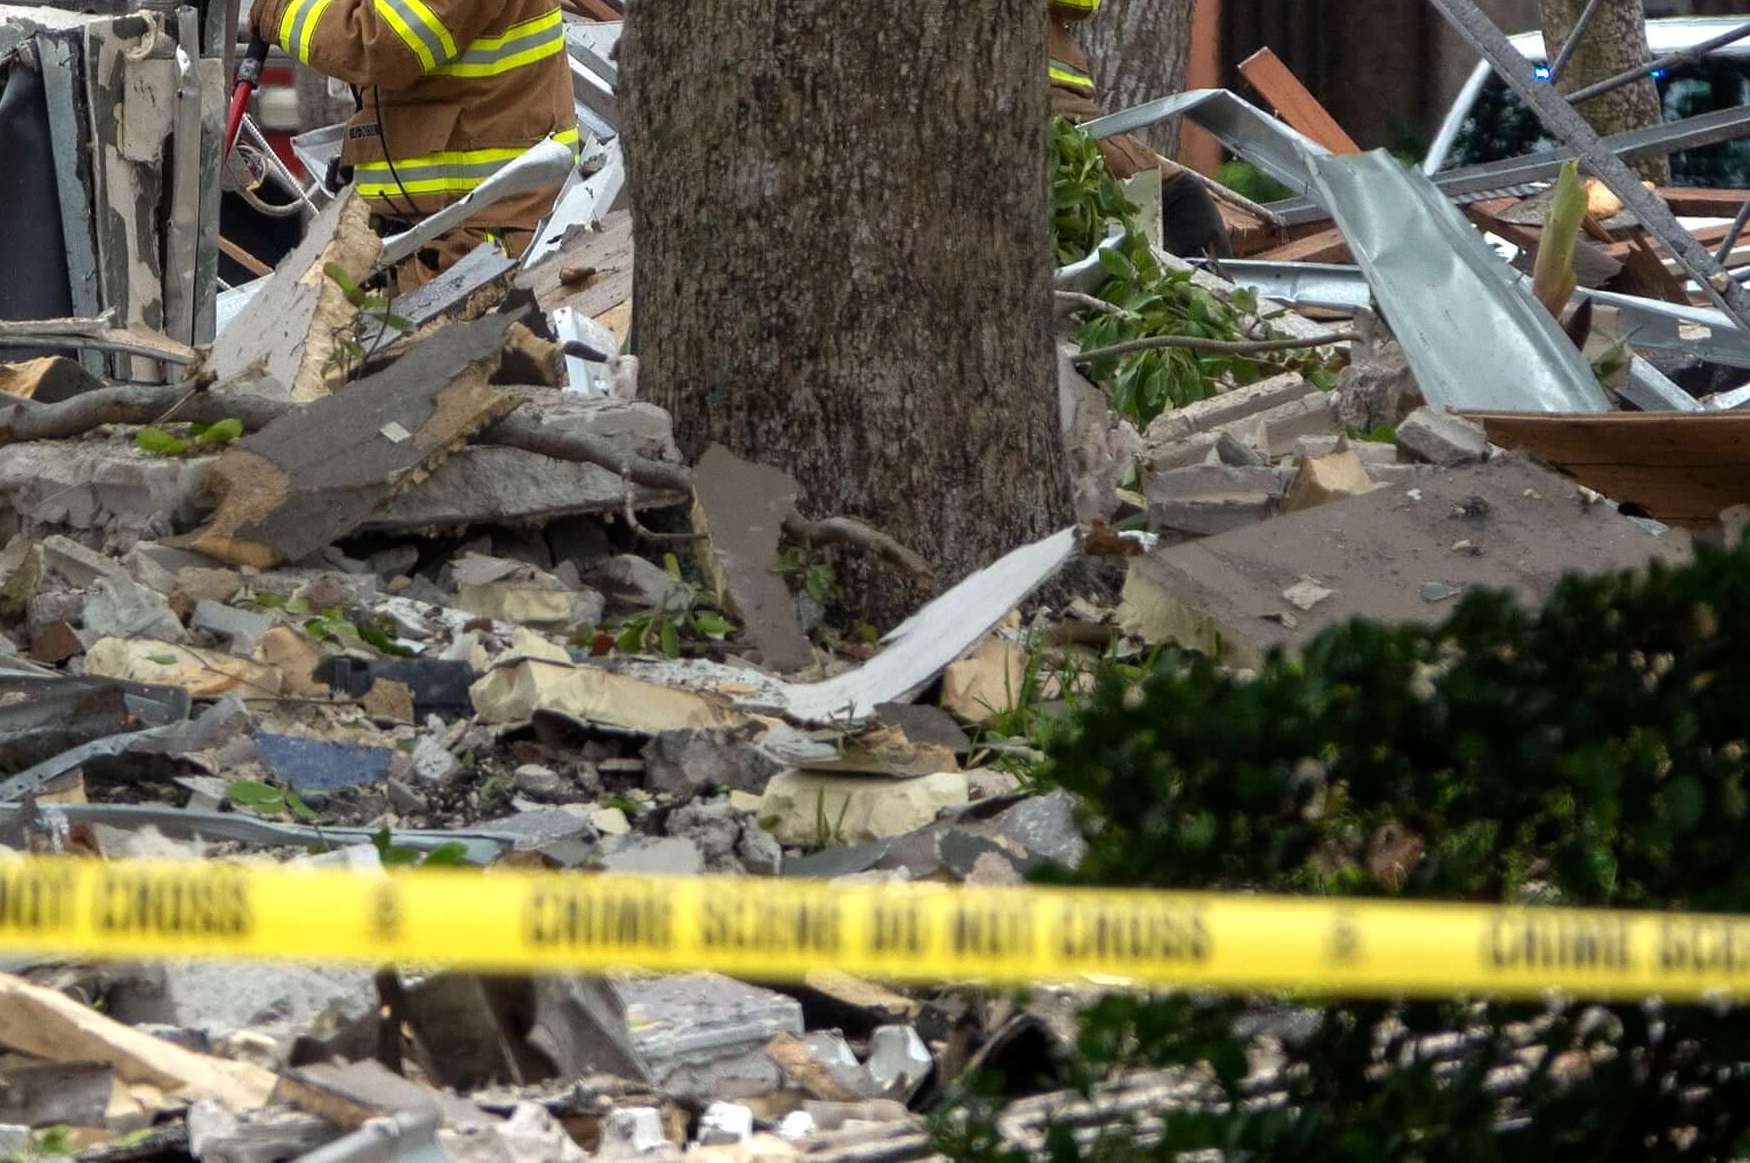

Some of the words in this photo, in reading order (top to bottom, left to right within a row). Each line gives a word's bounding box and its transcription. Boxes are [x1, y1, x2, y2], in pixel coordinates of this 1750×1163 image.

[93, 867, 253, 937] CROSS
[522, 883, 676, 950] CRIME
[698, 888, 846, 954] SCENE
[867, 891, 932, 956] DO
[950, 892, 1035, 958] NOT
[1054, 896, 1212, 961] CROSS
[1481, 906, 1636, 972] CRIME
